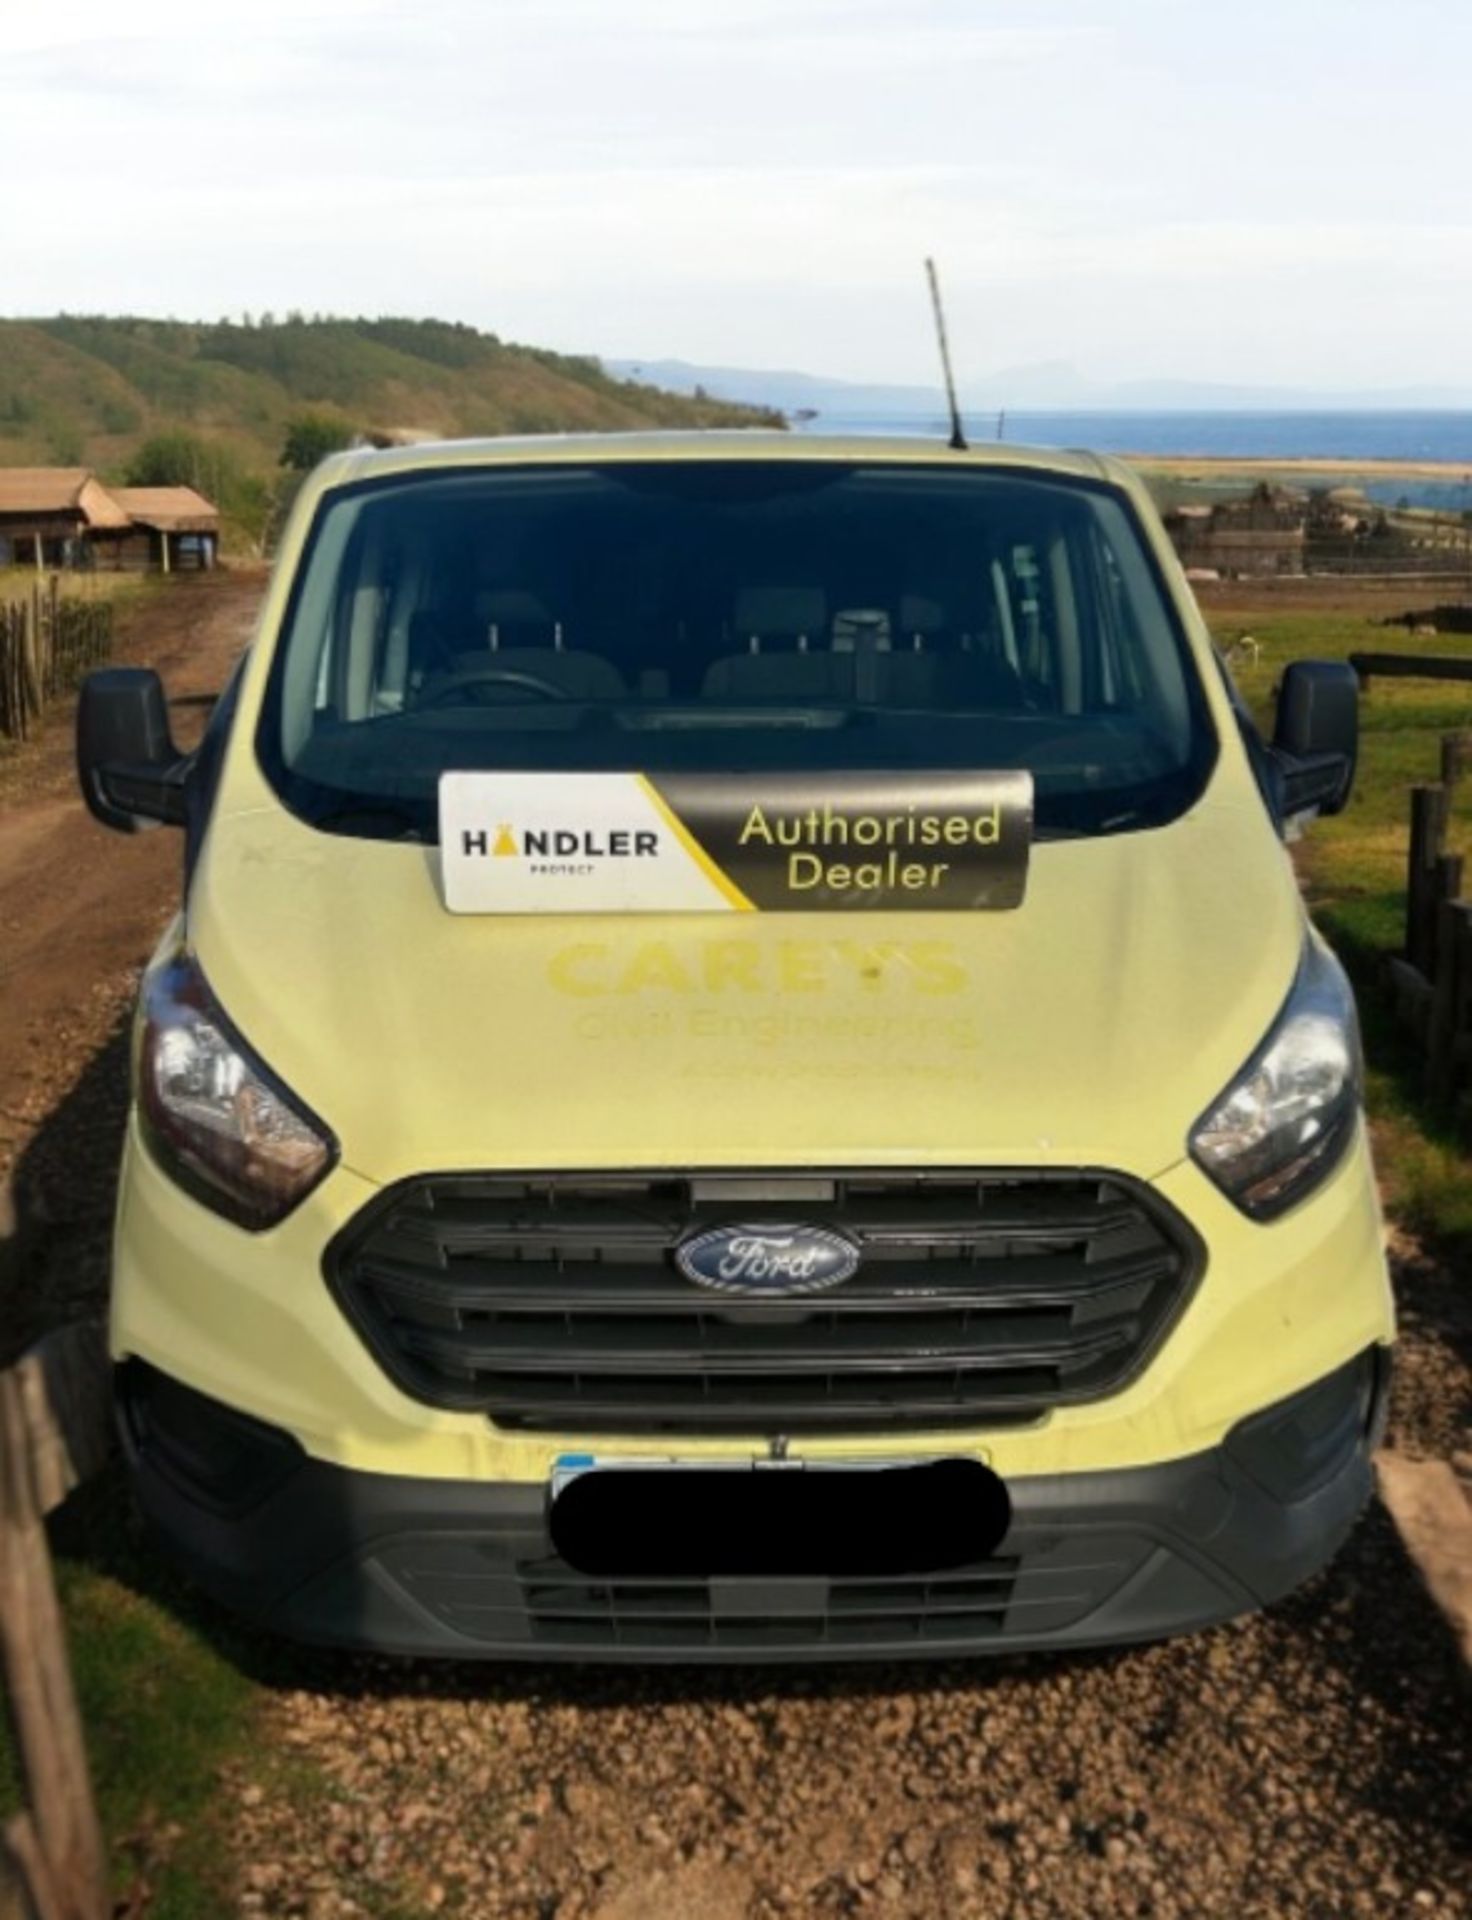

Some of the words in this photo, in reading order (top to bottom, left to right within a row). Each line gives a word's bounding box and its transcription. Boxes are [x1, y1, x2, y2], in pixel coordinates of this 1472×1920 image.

[462, 827, 659, 857] HANDLER
[738, 802, 1000, 845] Authorised
[788, 851, 948, 890] Dealer
[546, 940, 971, 997] CAREYS
[688, 1009, 982, 1049] Engineering
[718, 1236, 817, 1280] Ford
